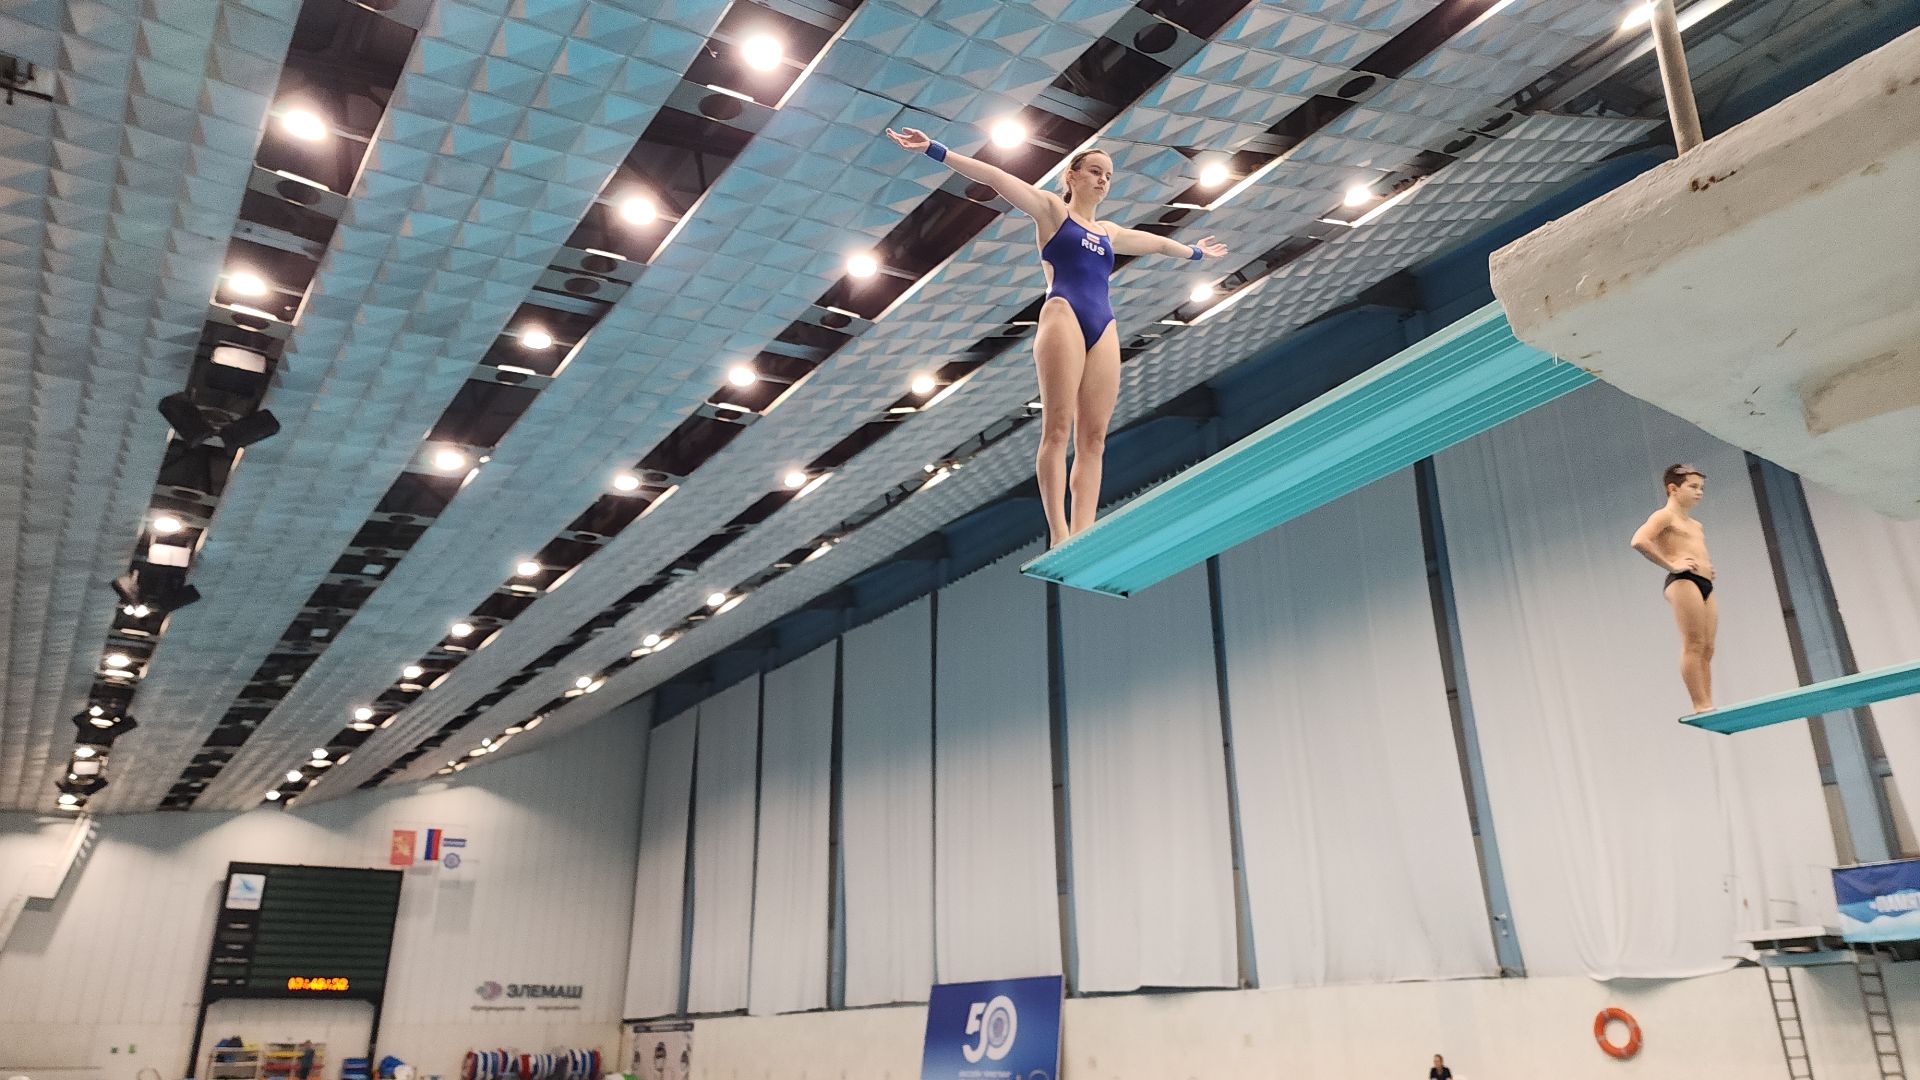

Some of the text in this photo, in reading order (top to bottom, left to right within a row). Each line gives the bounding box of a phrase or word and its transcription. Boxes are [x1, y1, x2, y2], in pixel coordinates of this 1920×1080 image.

[1081, 238, 1105, 256] RUS
[506, 984, 583, 998] ЭЛЕМАШ
[962, 995, 1018, 1063] 50
